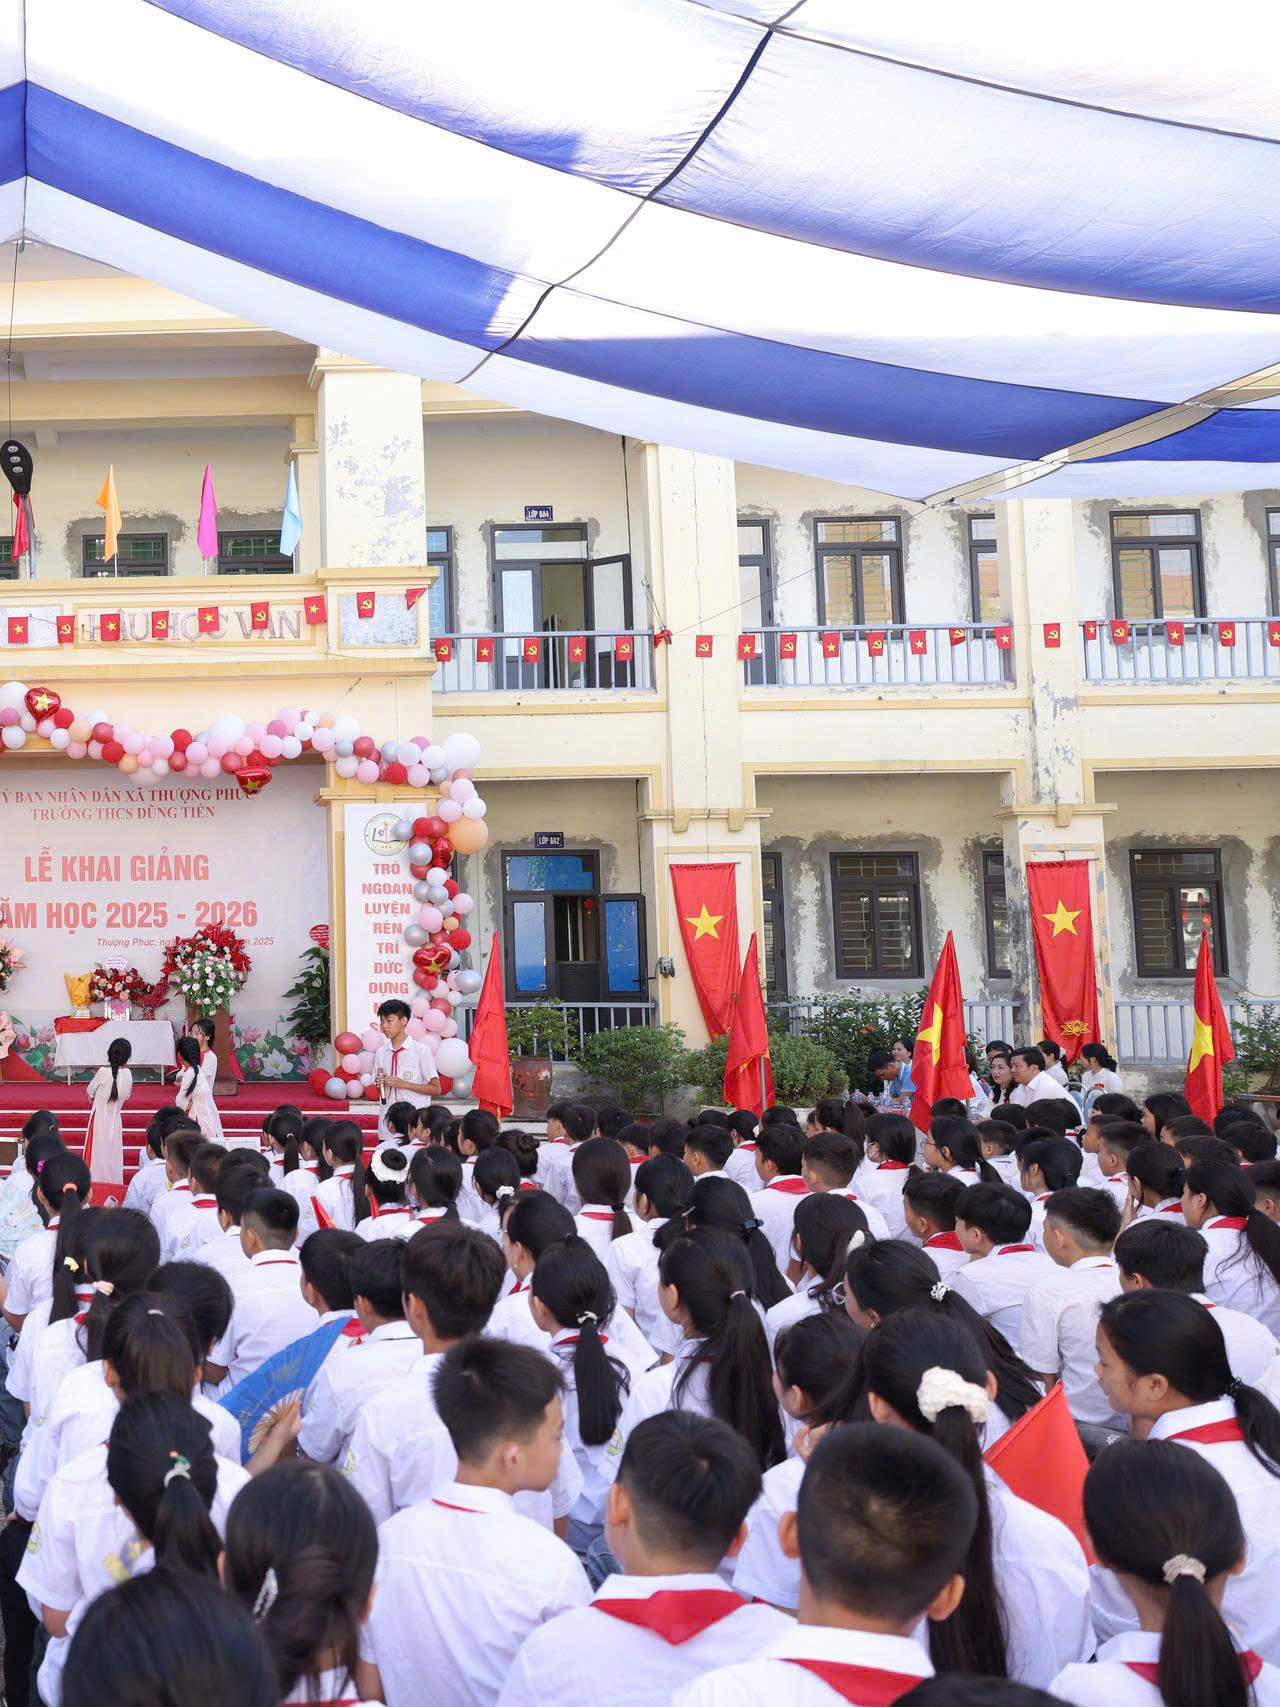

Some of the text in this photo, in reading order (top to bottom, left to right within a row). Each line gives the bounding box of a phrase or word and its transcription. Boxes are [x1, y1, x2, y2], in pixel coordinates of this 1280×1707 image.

[15, 791, 44, 803] BAN
[48, 787, 88, 802] NHÂN
[92, 786, 121, 802] DÂN
[125, 787, 144, 802] XÃ
[149, 787, 211, 804] THƯỢNG
[32, 805, 92, 820] TRƯỜNG
[96, 807, 133, 820] THCS
[137, 804, 177, 819] DŨNG
[24, 846, 210, 882] LỄ KHAI GIẢNG
[361, 883, 413, 895] NGOAN
[364, 900, 411, 917] LUYỆN
[46, 902, 97, 934] HỌC
[105, 901, 168, 929] 2025
[195, 900, 258, 928] 2026
[253, 936, 274, 946] 2025
[376, 940, 400, 954] TRÍ
[373, 960, 403, 974] ĐỨC
[368, 981, 409, 996] DỰNG
